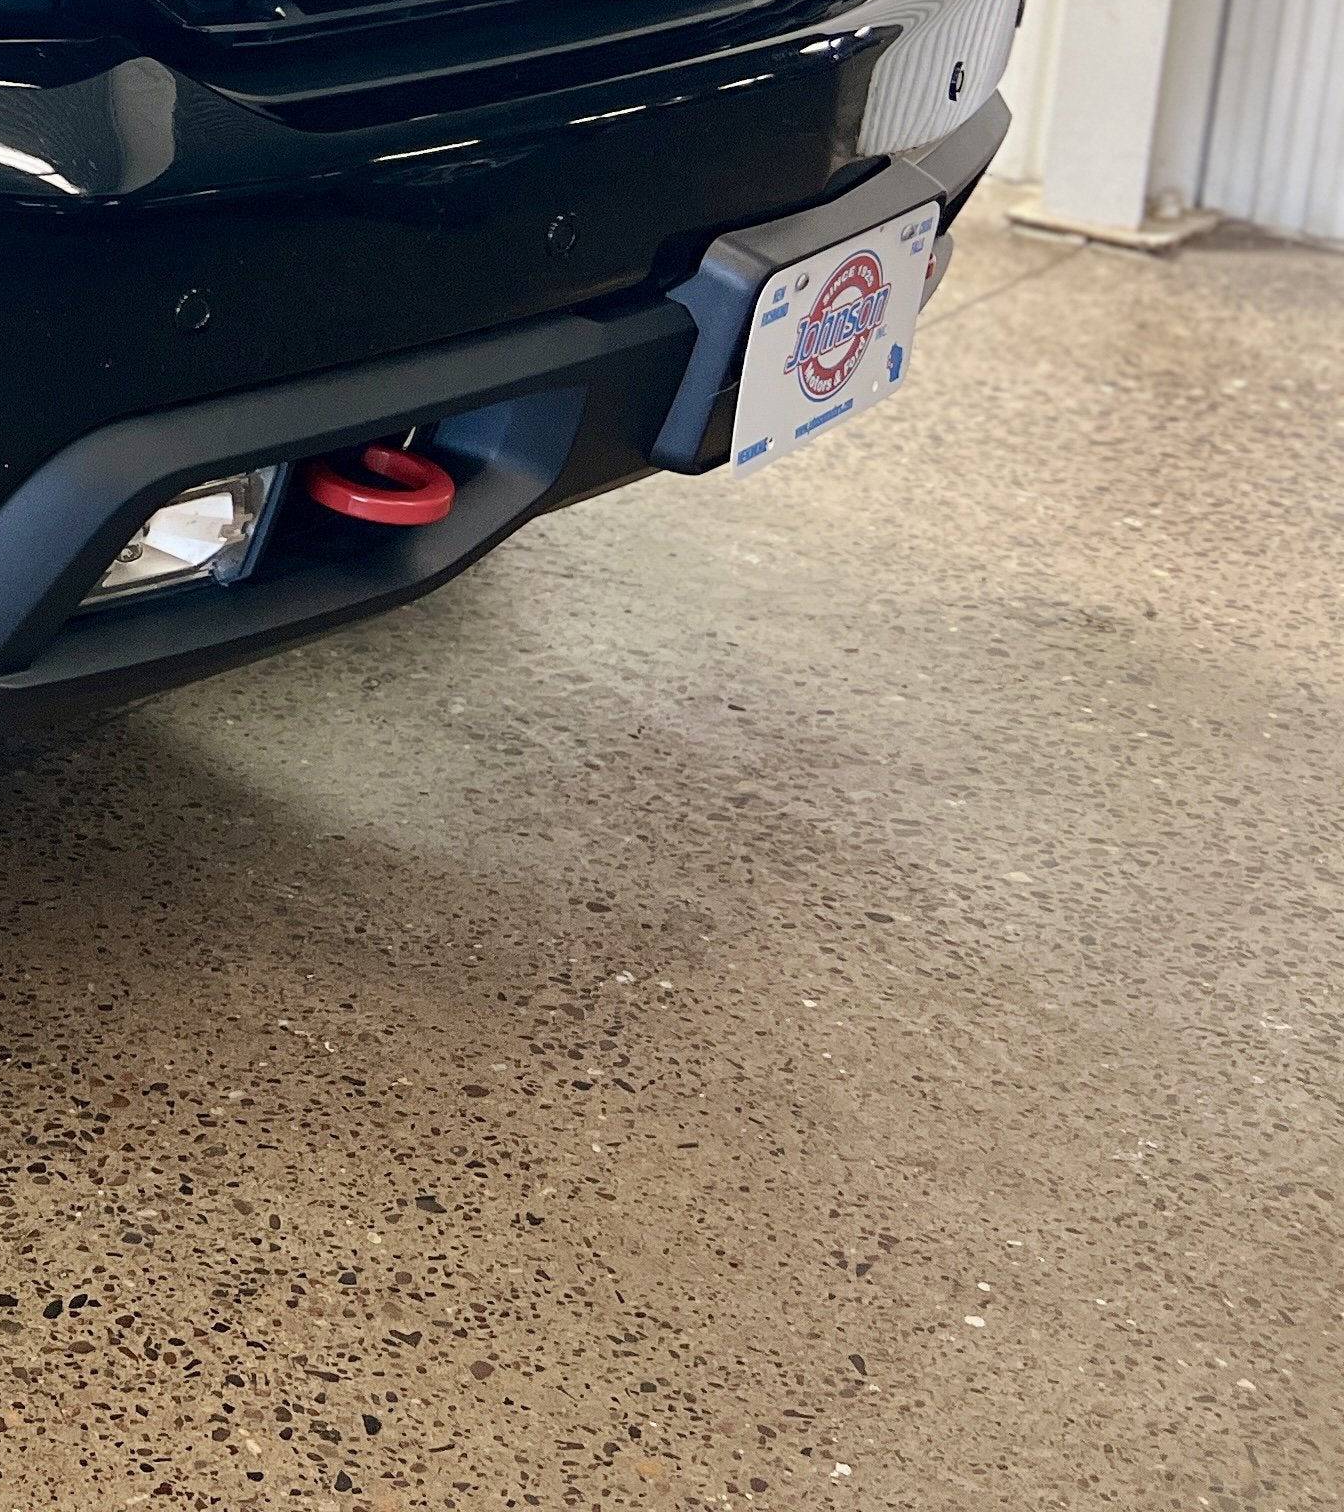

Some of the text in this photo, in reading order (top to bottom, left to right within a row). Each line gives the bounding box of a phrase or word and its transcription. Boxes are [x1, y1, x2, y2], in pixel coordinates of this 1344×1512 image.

[823, 265, 856, 306] SINCE
[785, 284, 891, 373] Johnson
[804, 335, 866, 393] Motors & Ford
